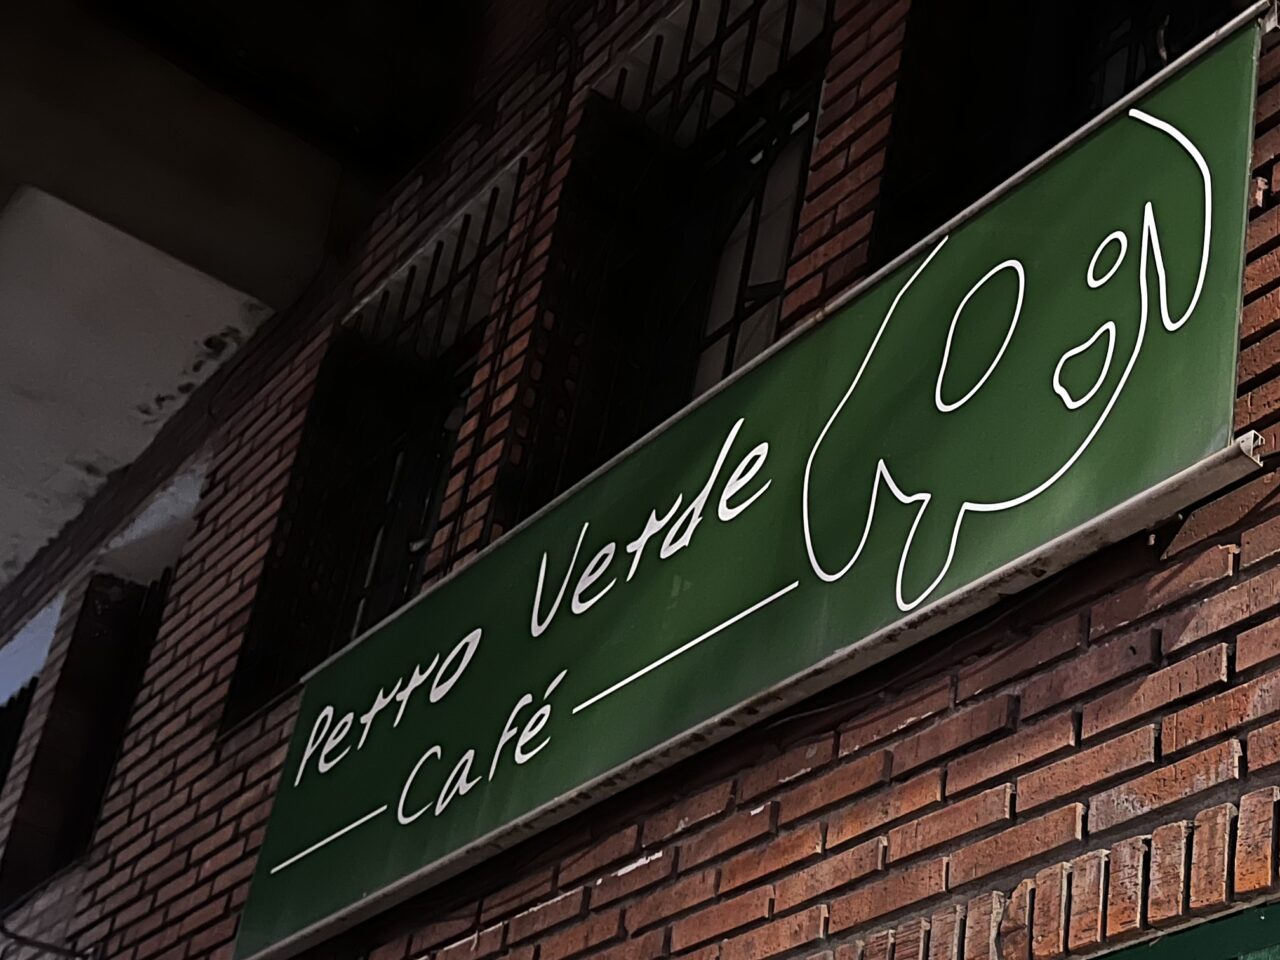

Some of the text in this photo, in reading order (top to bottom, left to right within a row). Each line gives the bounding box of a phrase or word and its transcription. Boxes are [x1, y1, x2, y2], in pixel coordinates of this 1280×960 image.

[294, 418, 772, 787] Perro Verde
[397, 669, 568, 824] Café
